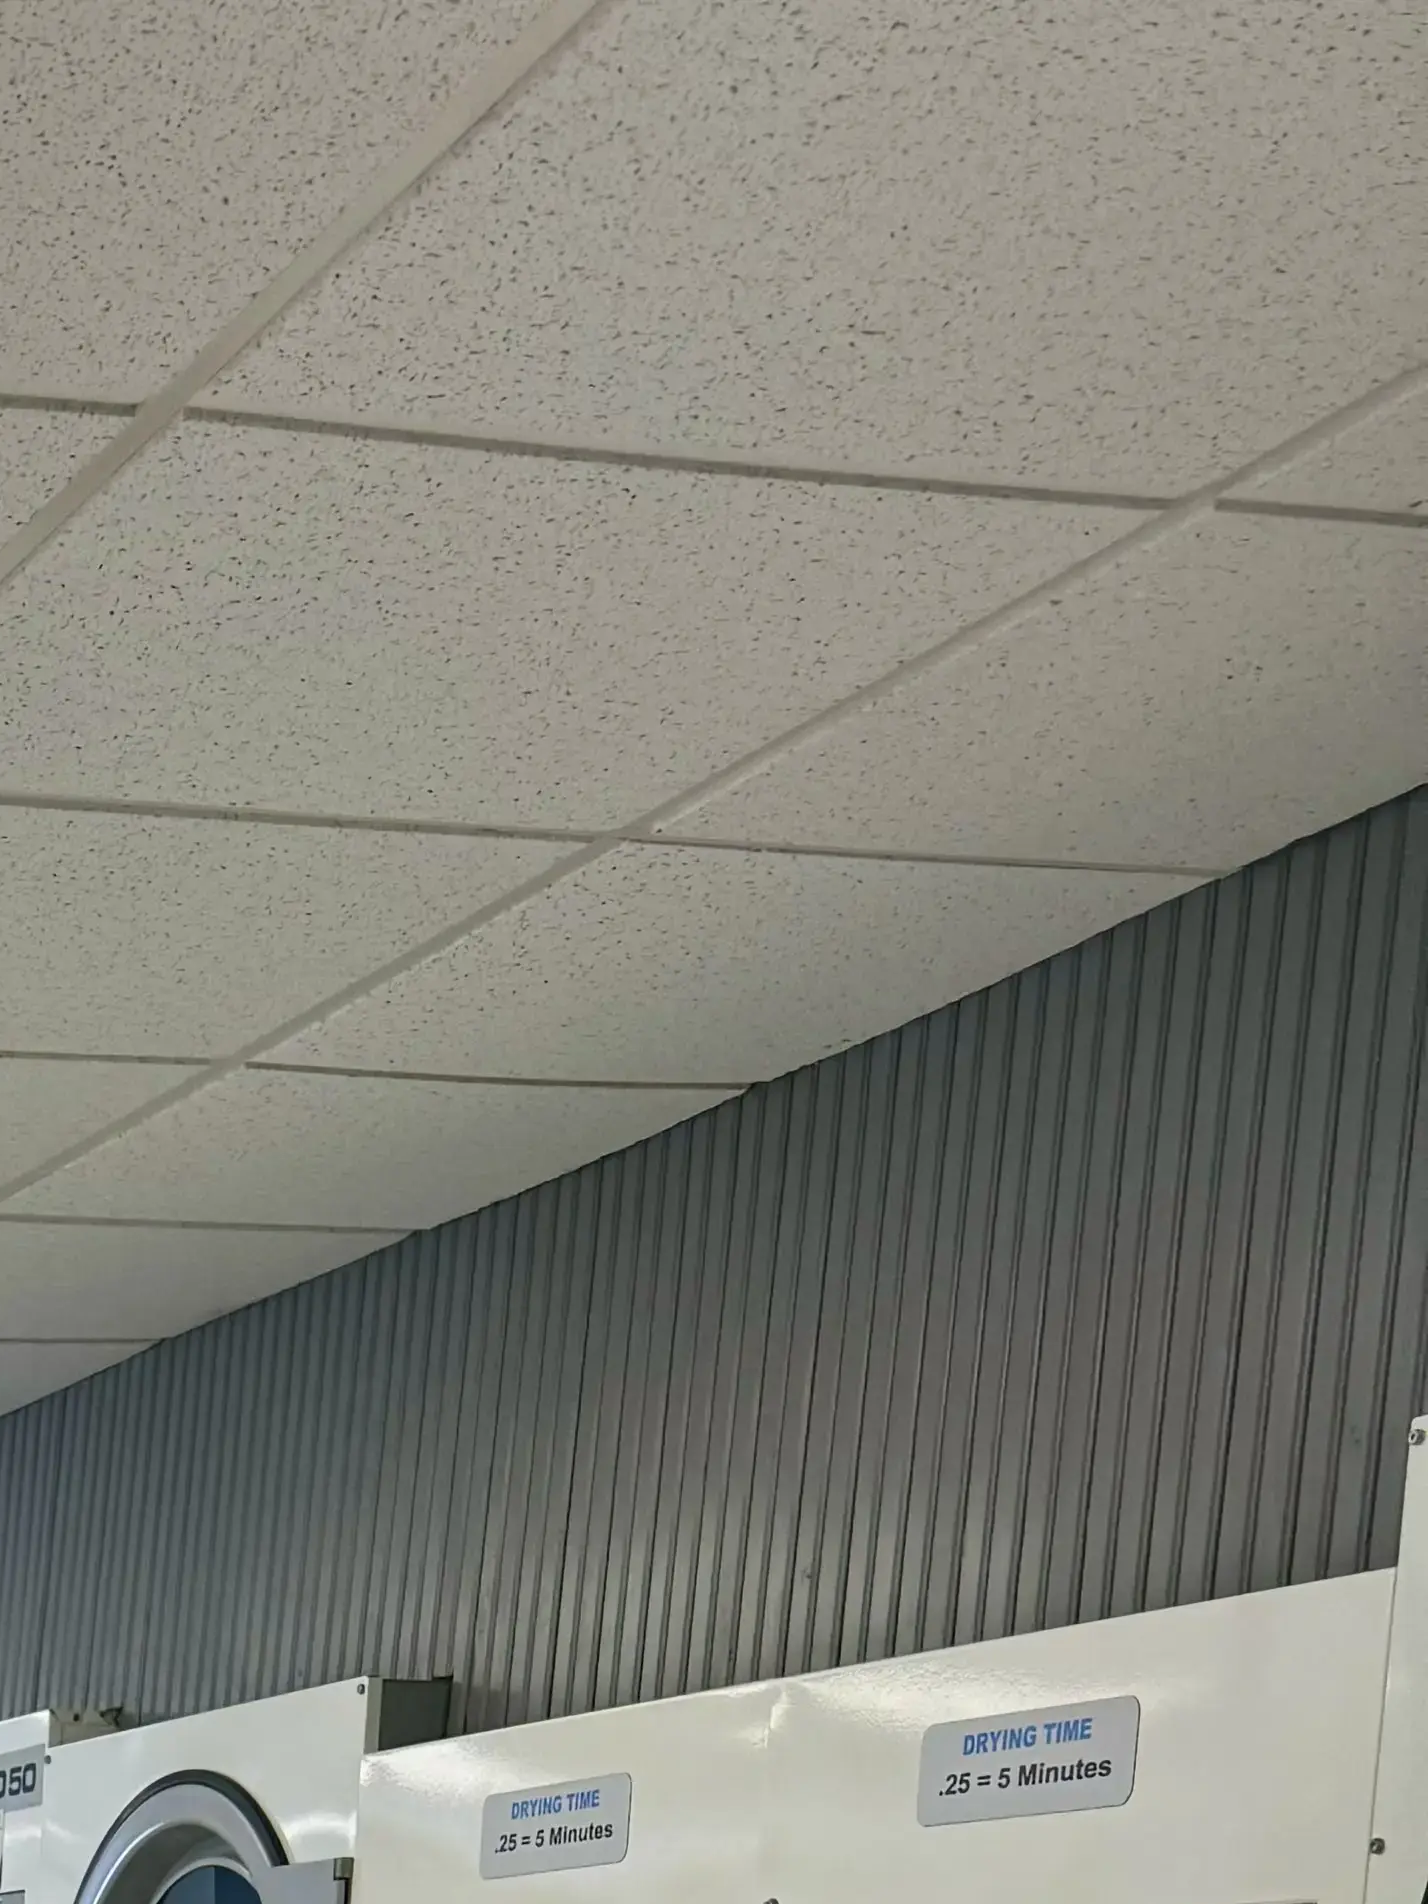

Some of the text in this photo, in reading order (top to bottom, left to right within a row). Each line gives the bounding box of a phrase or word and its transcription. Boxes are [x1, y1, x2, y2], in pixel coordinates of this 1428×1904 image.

[962, 1718, 1093, 1756] DRYING TIME
[938, 1759, 1112, 1797] .25 = 5 Minutes
[511, 1789, 600, 1820] DRYING TIME
[494, 1833, 517, 1854] .25
[535, 1829, 545, 1848] 5
[549, 1822, 613, 1846] Minutes
